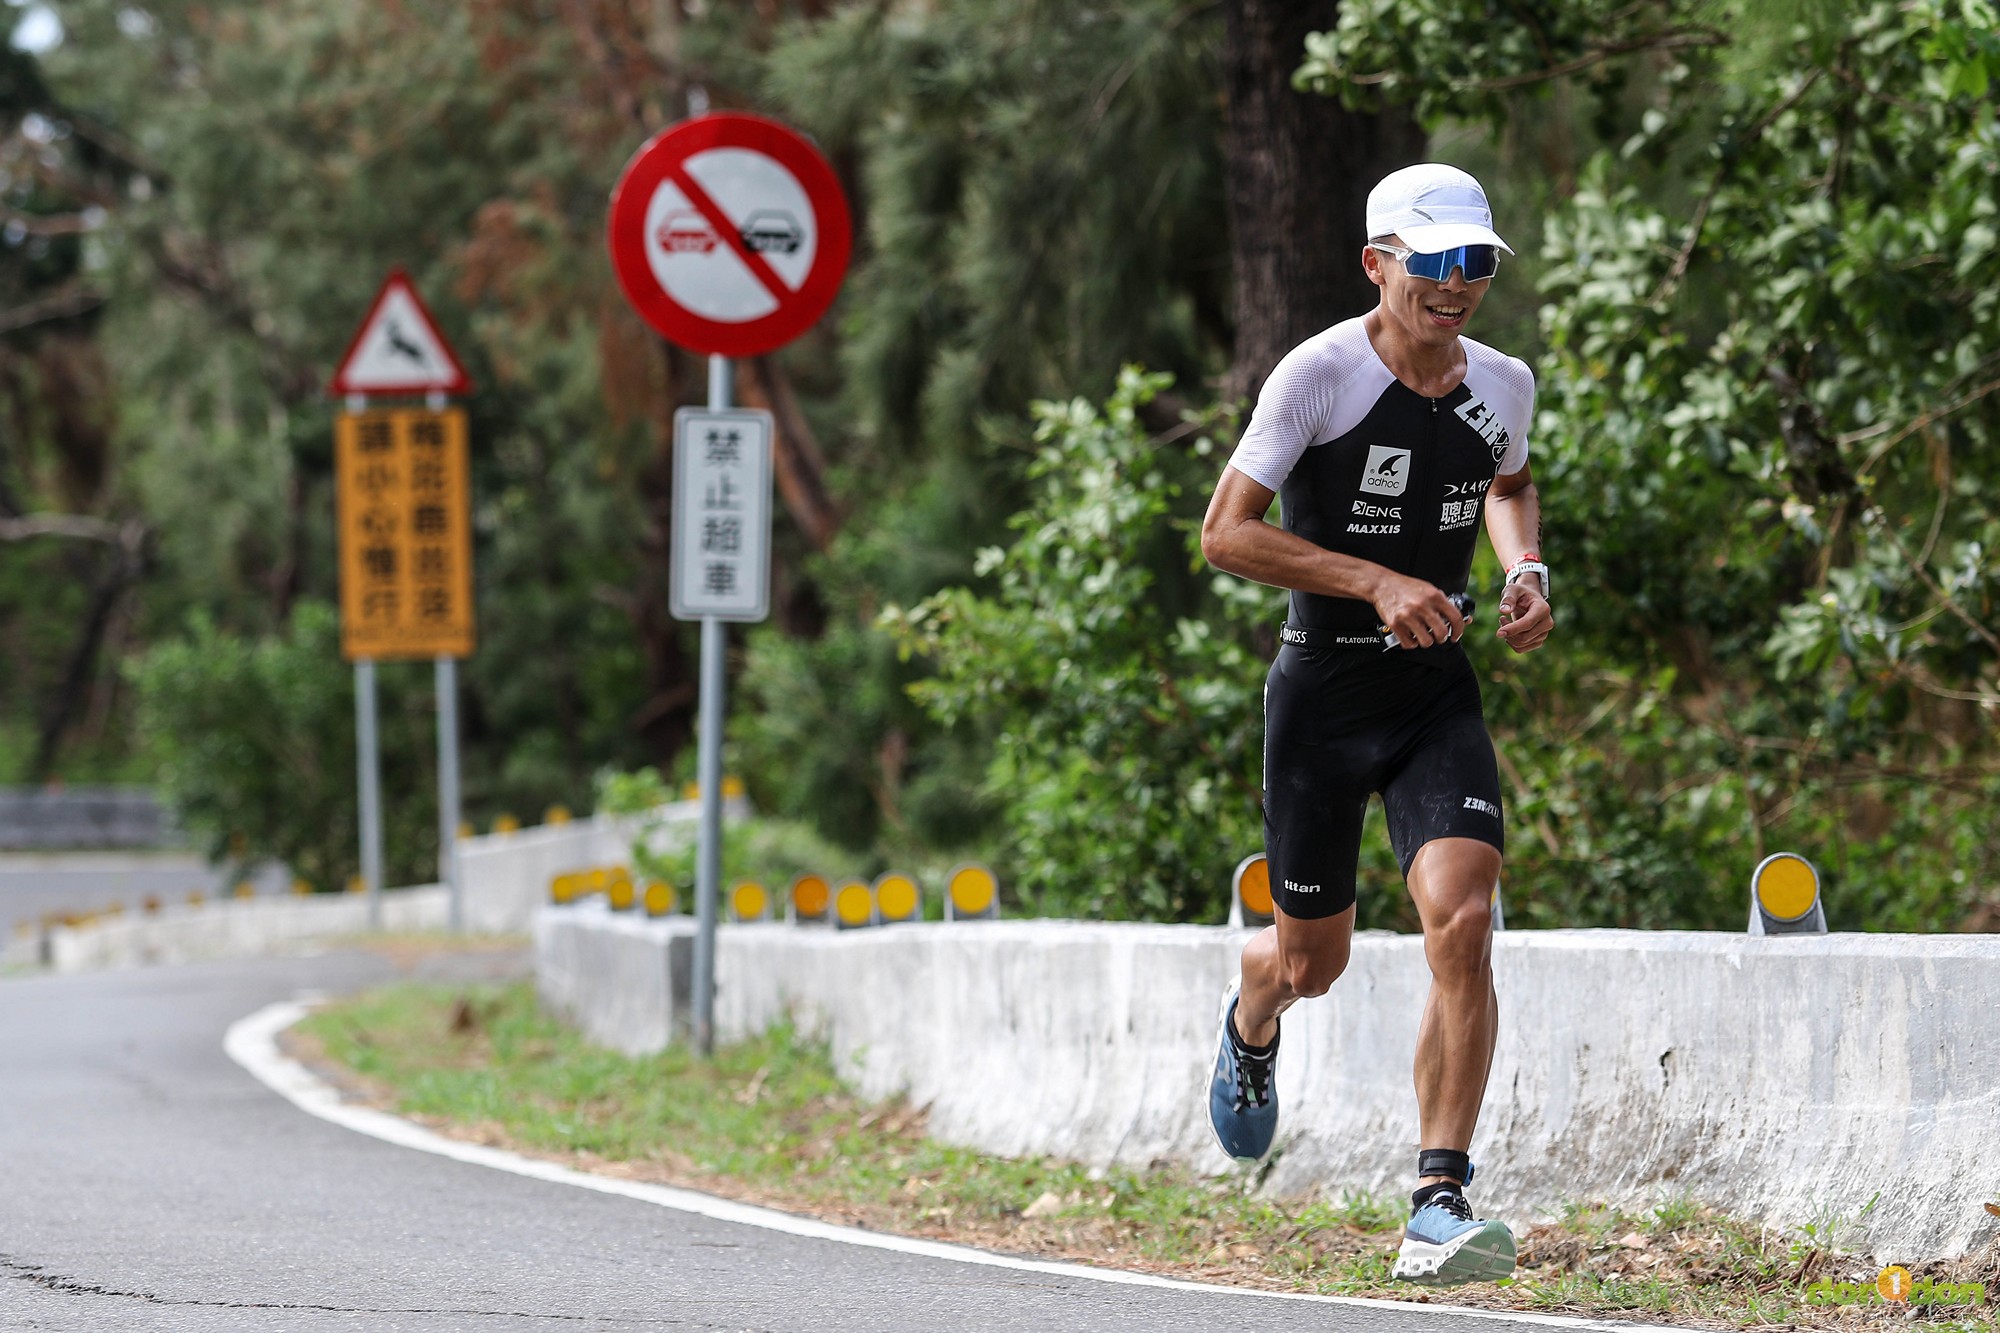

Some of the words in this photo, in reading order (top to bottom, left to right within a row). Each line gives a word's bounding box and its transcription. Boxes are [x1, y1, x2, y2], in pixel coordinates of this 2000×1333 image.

[1367, 476, 1400, 489] adhoc
[702, 426, 743, 597] 禁止超車
[1346, 523, 1401, 534] MAXXIS
[1284, 879, 1321, 894] titan
